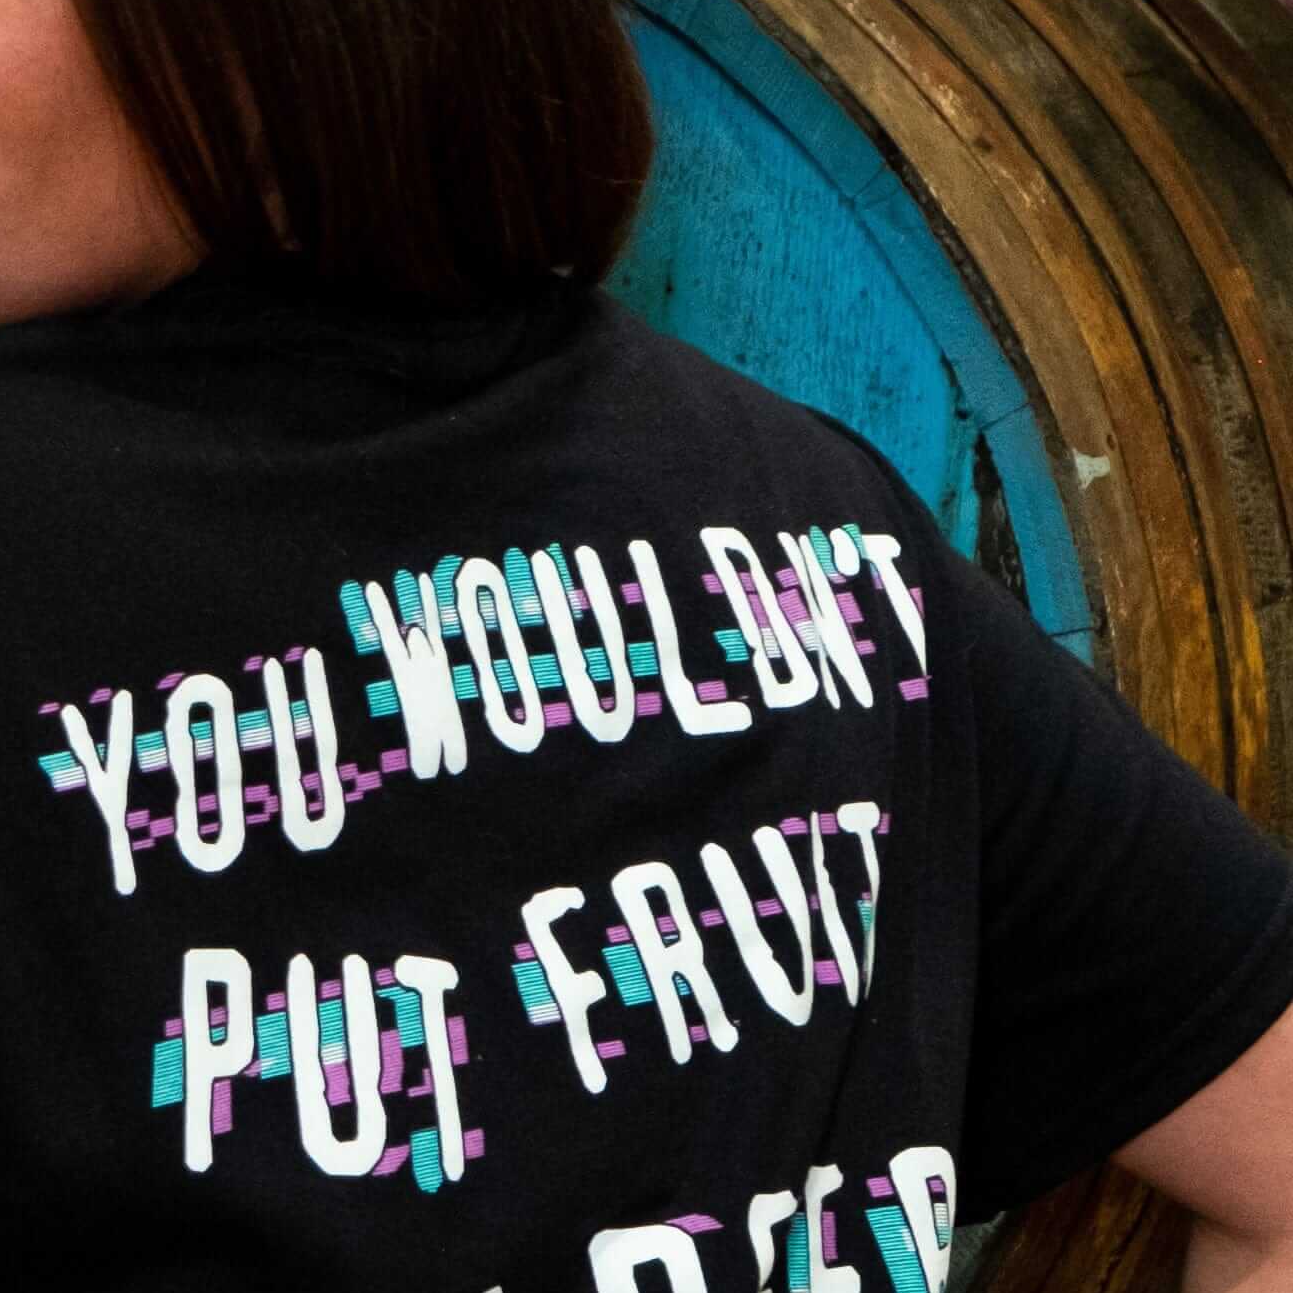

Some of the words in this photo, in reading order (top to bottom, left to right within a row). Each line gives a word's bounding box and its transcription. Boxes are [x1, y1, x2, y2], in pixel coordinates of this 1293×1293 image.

[62, 648, 345, 895] YOU
[362, 527, 927, 779] WOULDN'T
[182, 947, 466, 1182] PUT
[521, 801, 881, 1094] FRUIT
